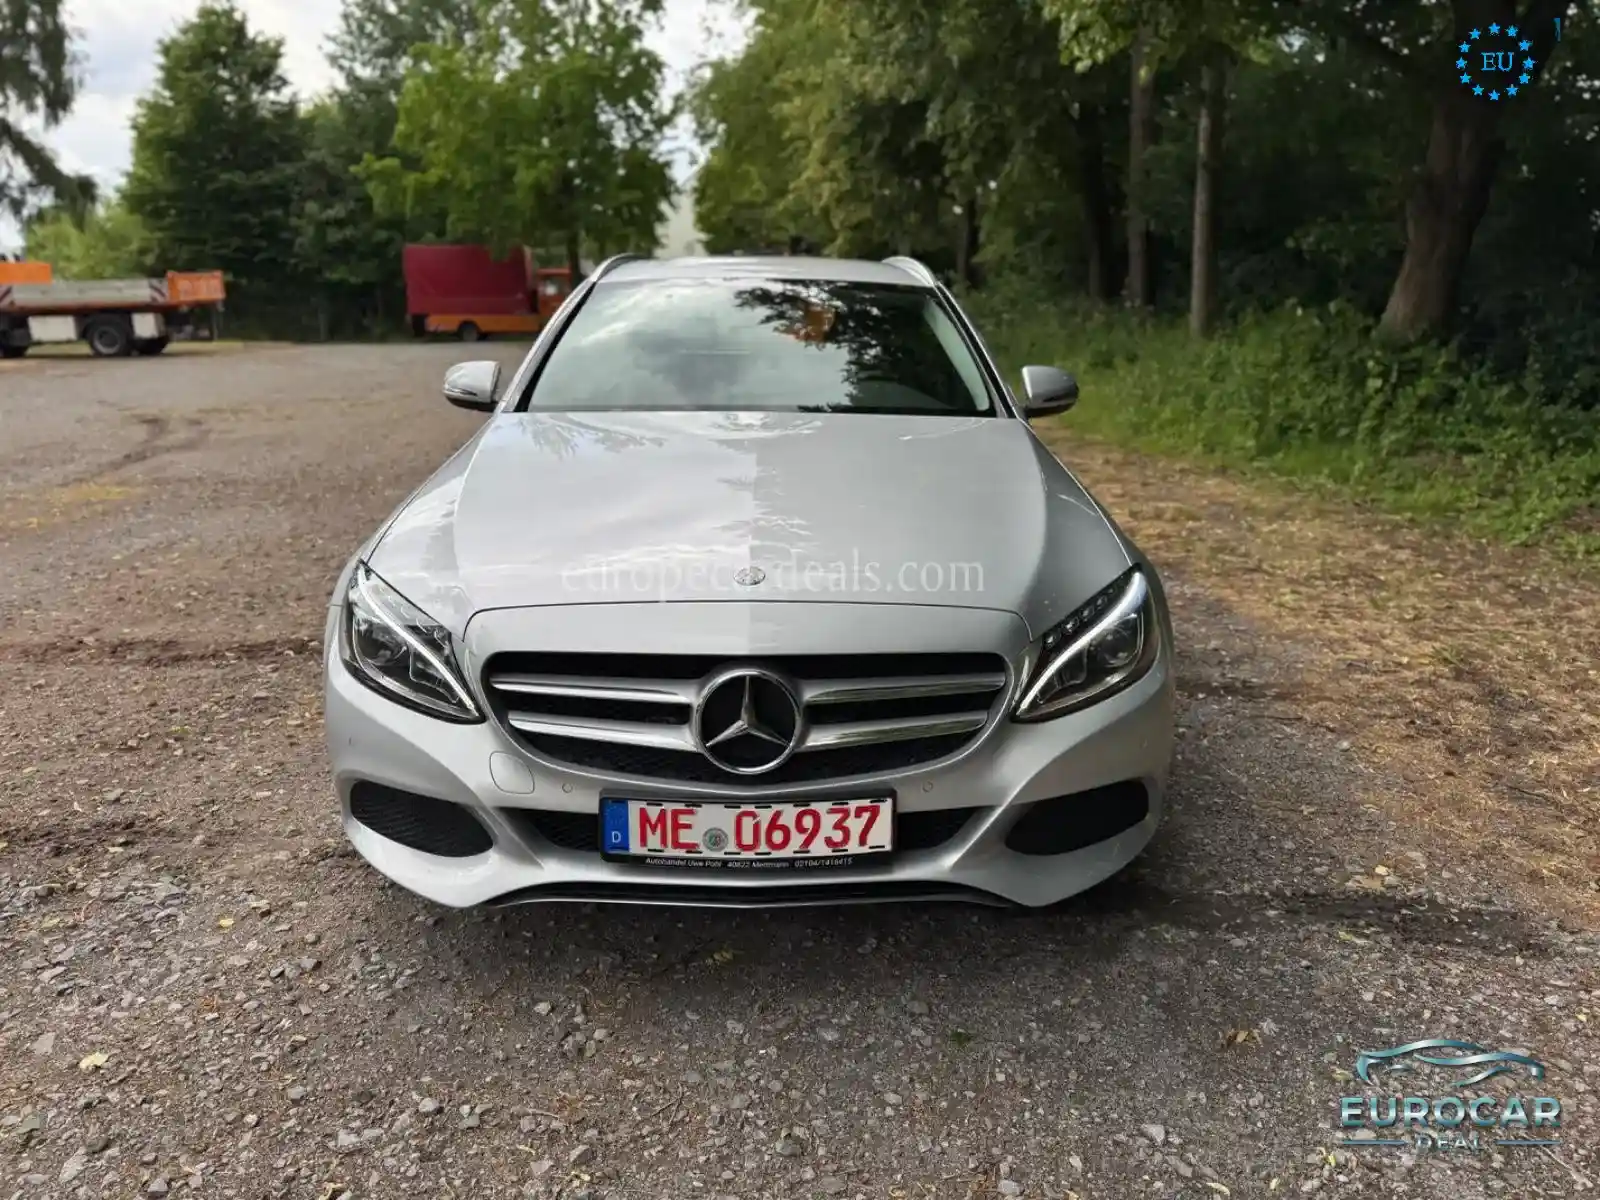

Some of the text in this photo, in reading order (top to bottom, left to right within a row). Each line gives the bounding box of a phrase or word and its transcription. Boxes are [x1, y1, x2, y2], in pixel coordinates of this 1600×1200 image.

[611, 830, 622, 843] D
[638, 804, 881, 853] ME 06937
